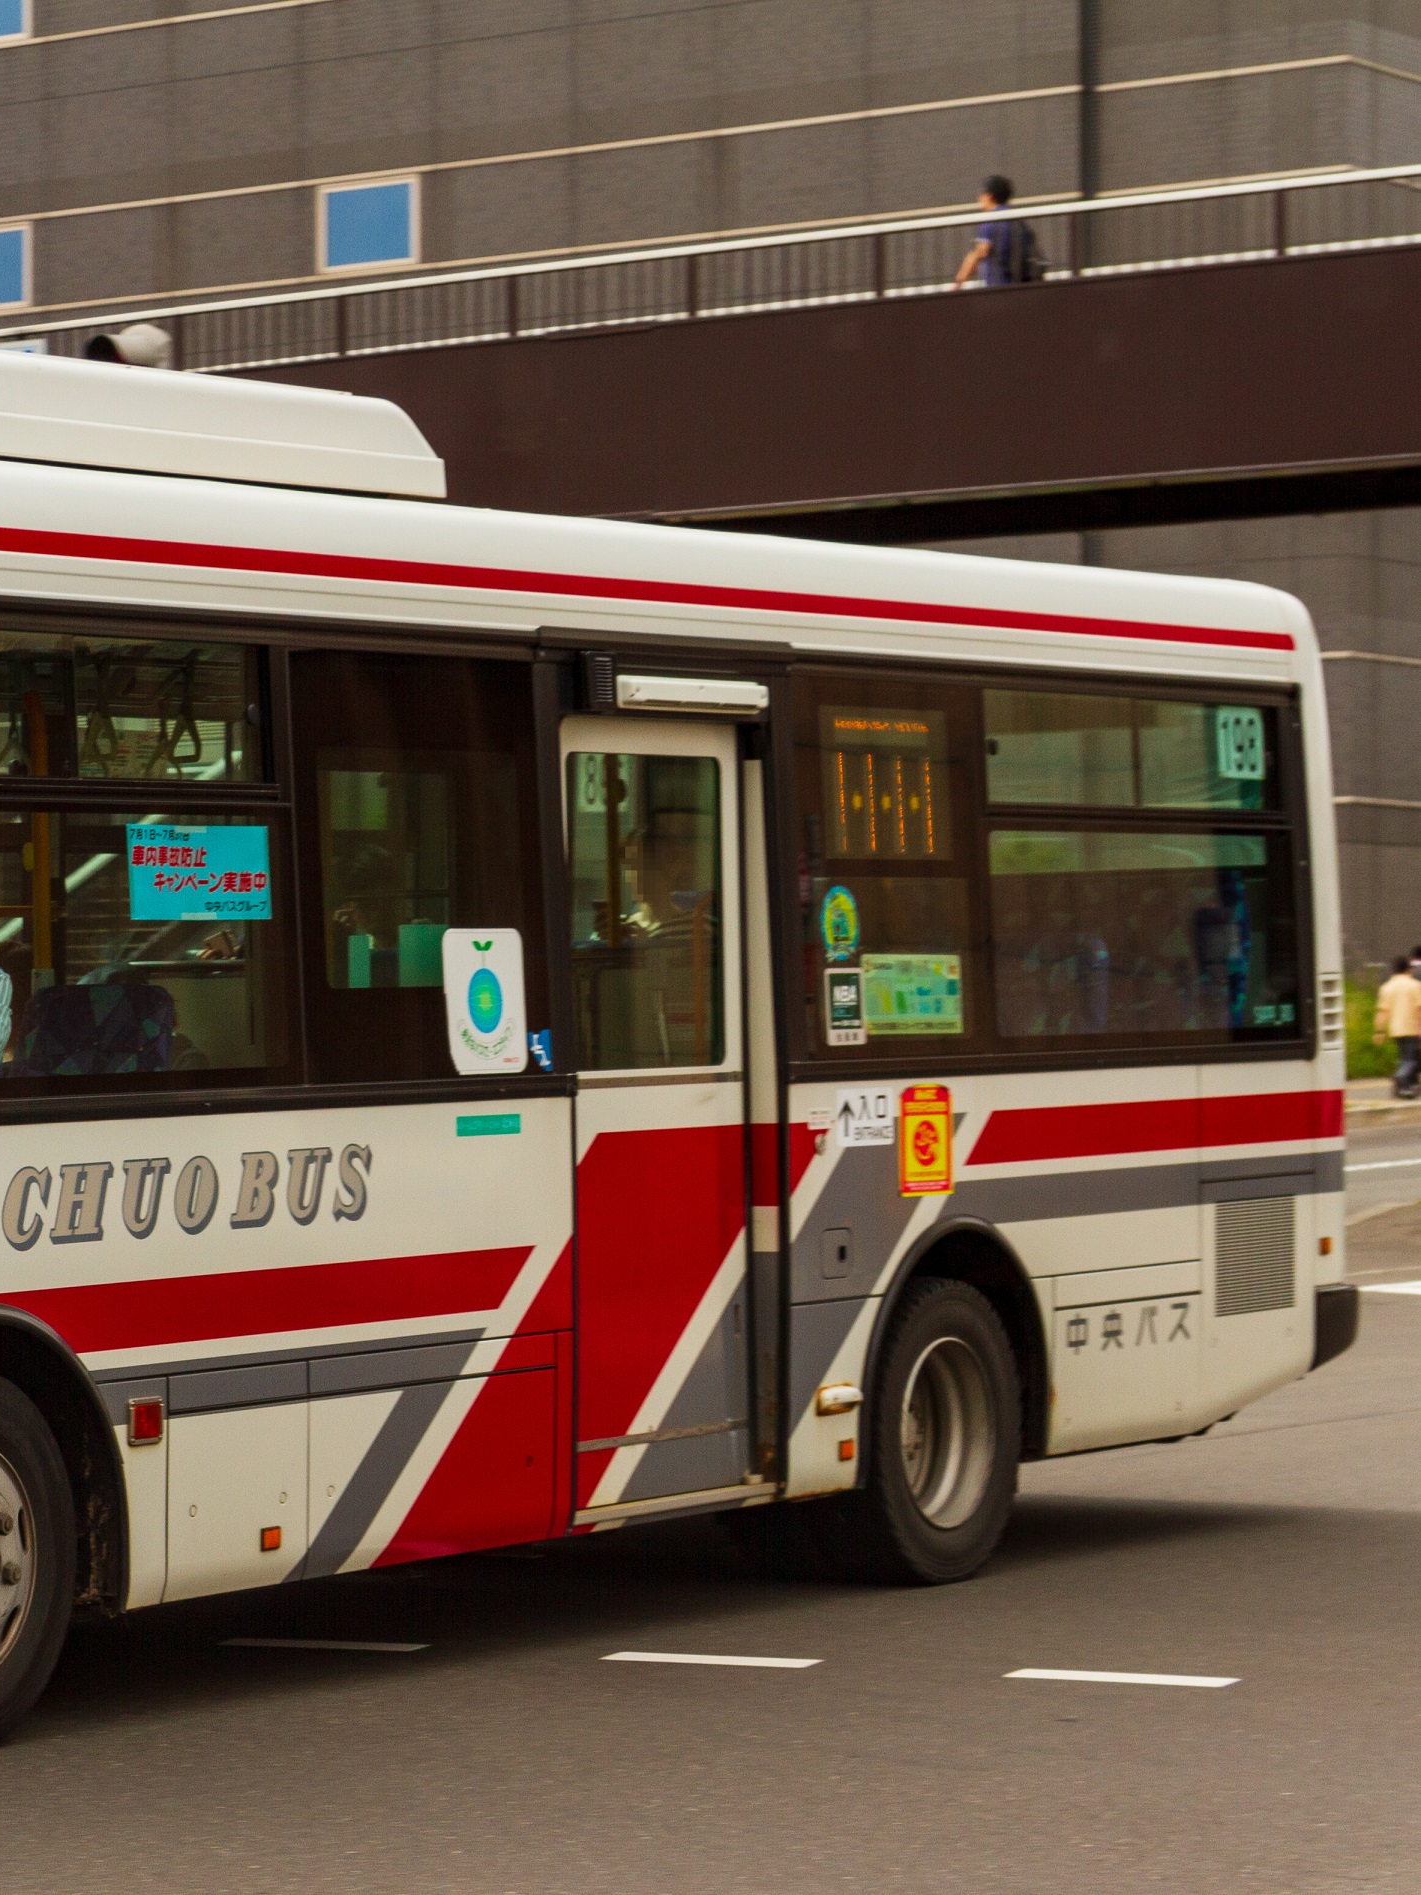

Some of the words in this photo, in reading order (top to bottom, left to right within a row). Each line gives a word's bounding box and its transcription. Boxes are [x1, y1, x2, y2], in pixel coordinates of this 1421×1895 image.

[131, 845, 208, 868] 車内事故防止
[153, 871, 267, 893] キャンペーン実施中
[205, 900, 267, 912] 中央バスグループ
[1, 1155, 219, 1251] CHUO
[230, 1143, 373, 1229] BUS
[1065, 1302, 1192, 1355] 中央バス
